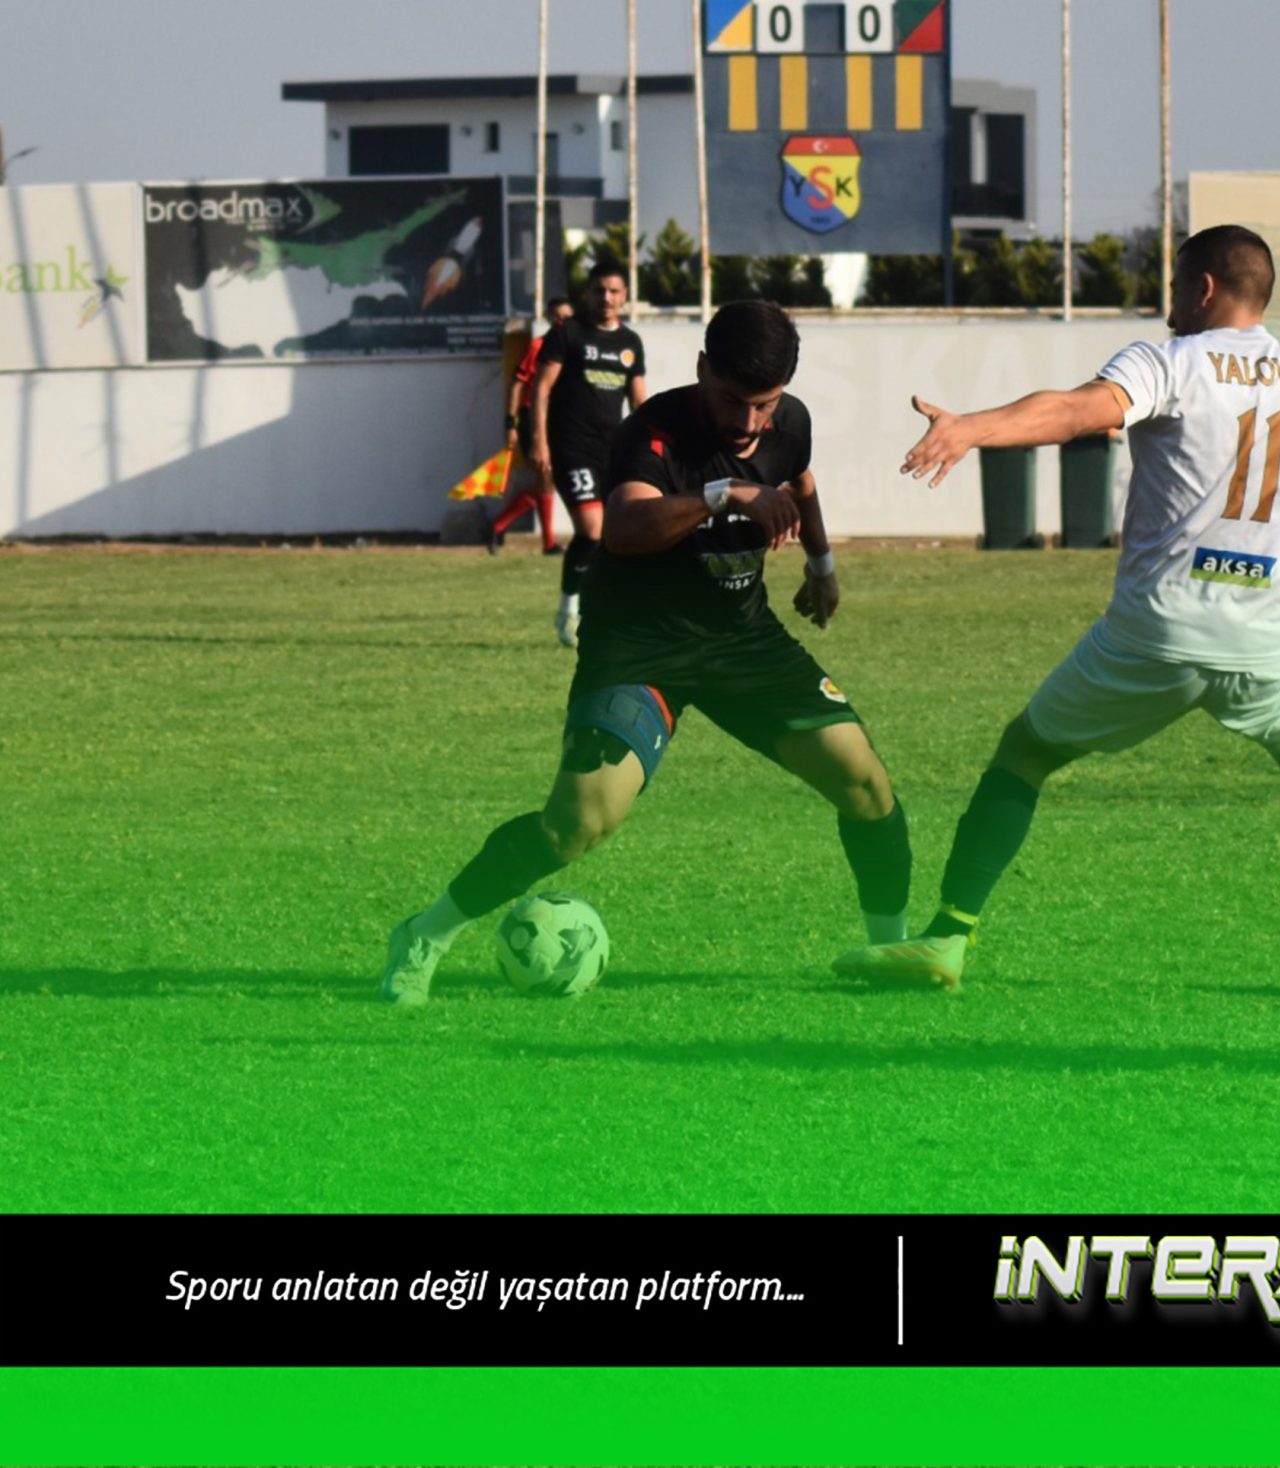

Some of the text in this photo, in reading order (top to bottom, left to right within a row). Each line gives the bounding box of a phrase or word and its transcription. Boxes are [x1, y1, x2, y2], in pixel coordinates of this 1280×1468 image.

[769, 5, 880, 42] 0 0
[145, 190, 303, 223] broadmax
[0, 243, 98, 294] ank
[570, 469, 594, 492] 33
